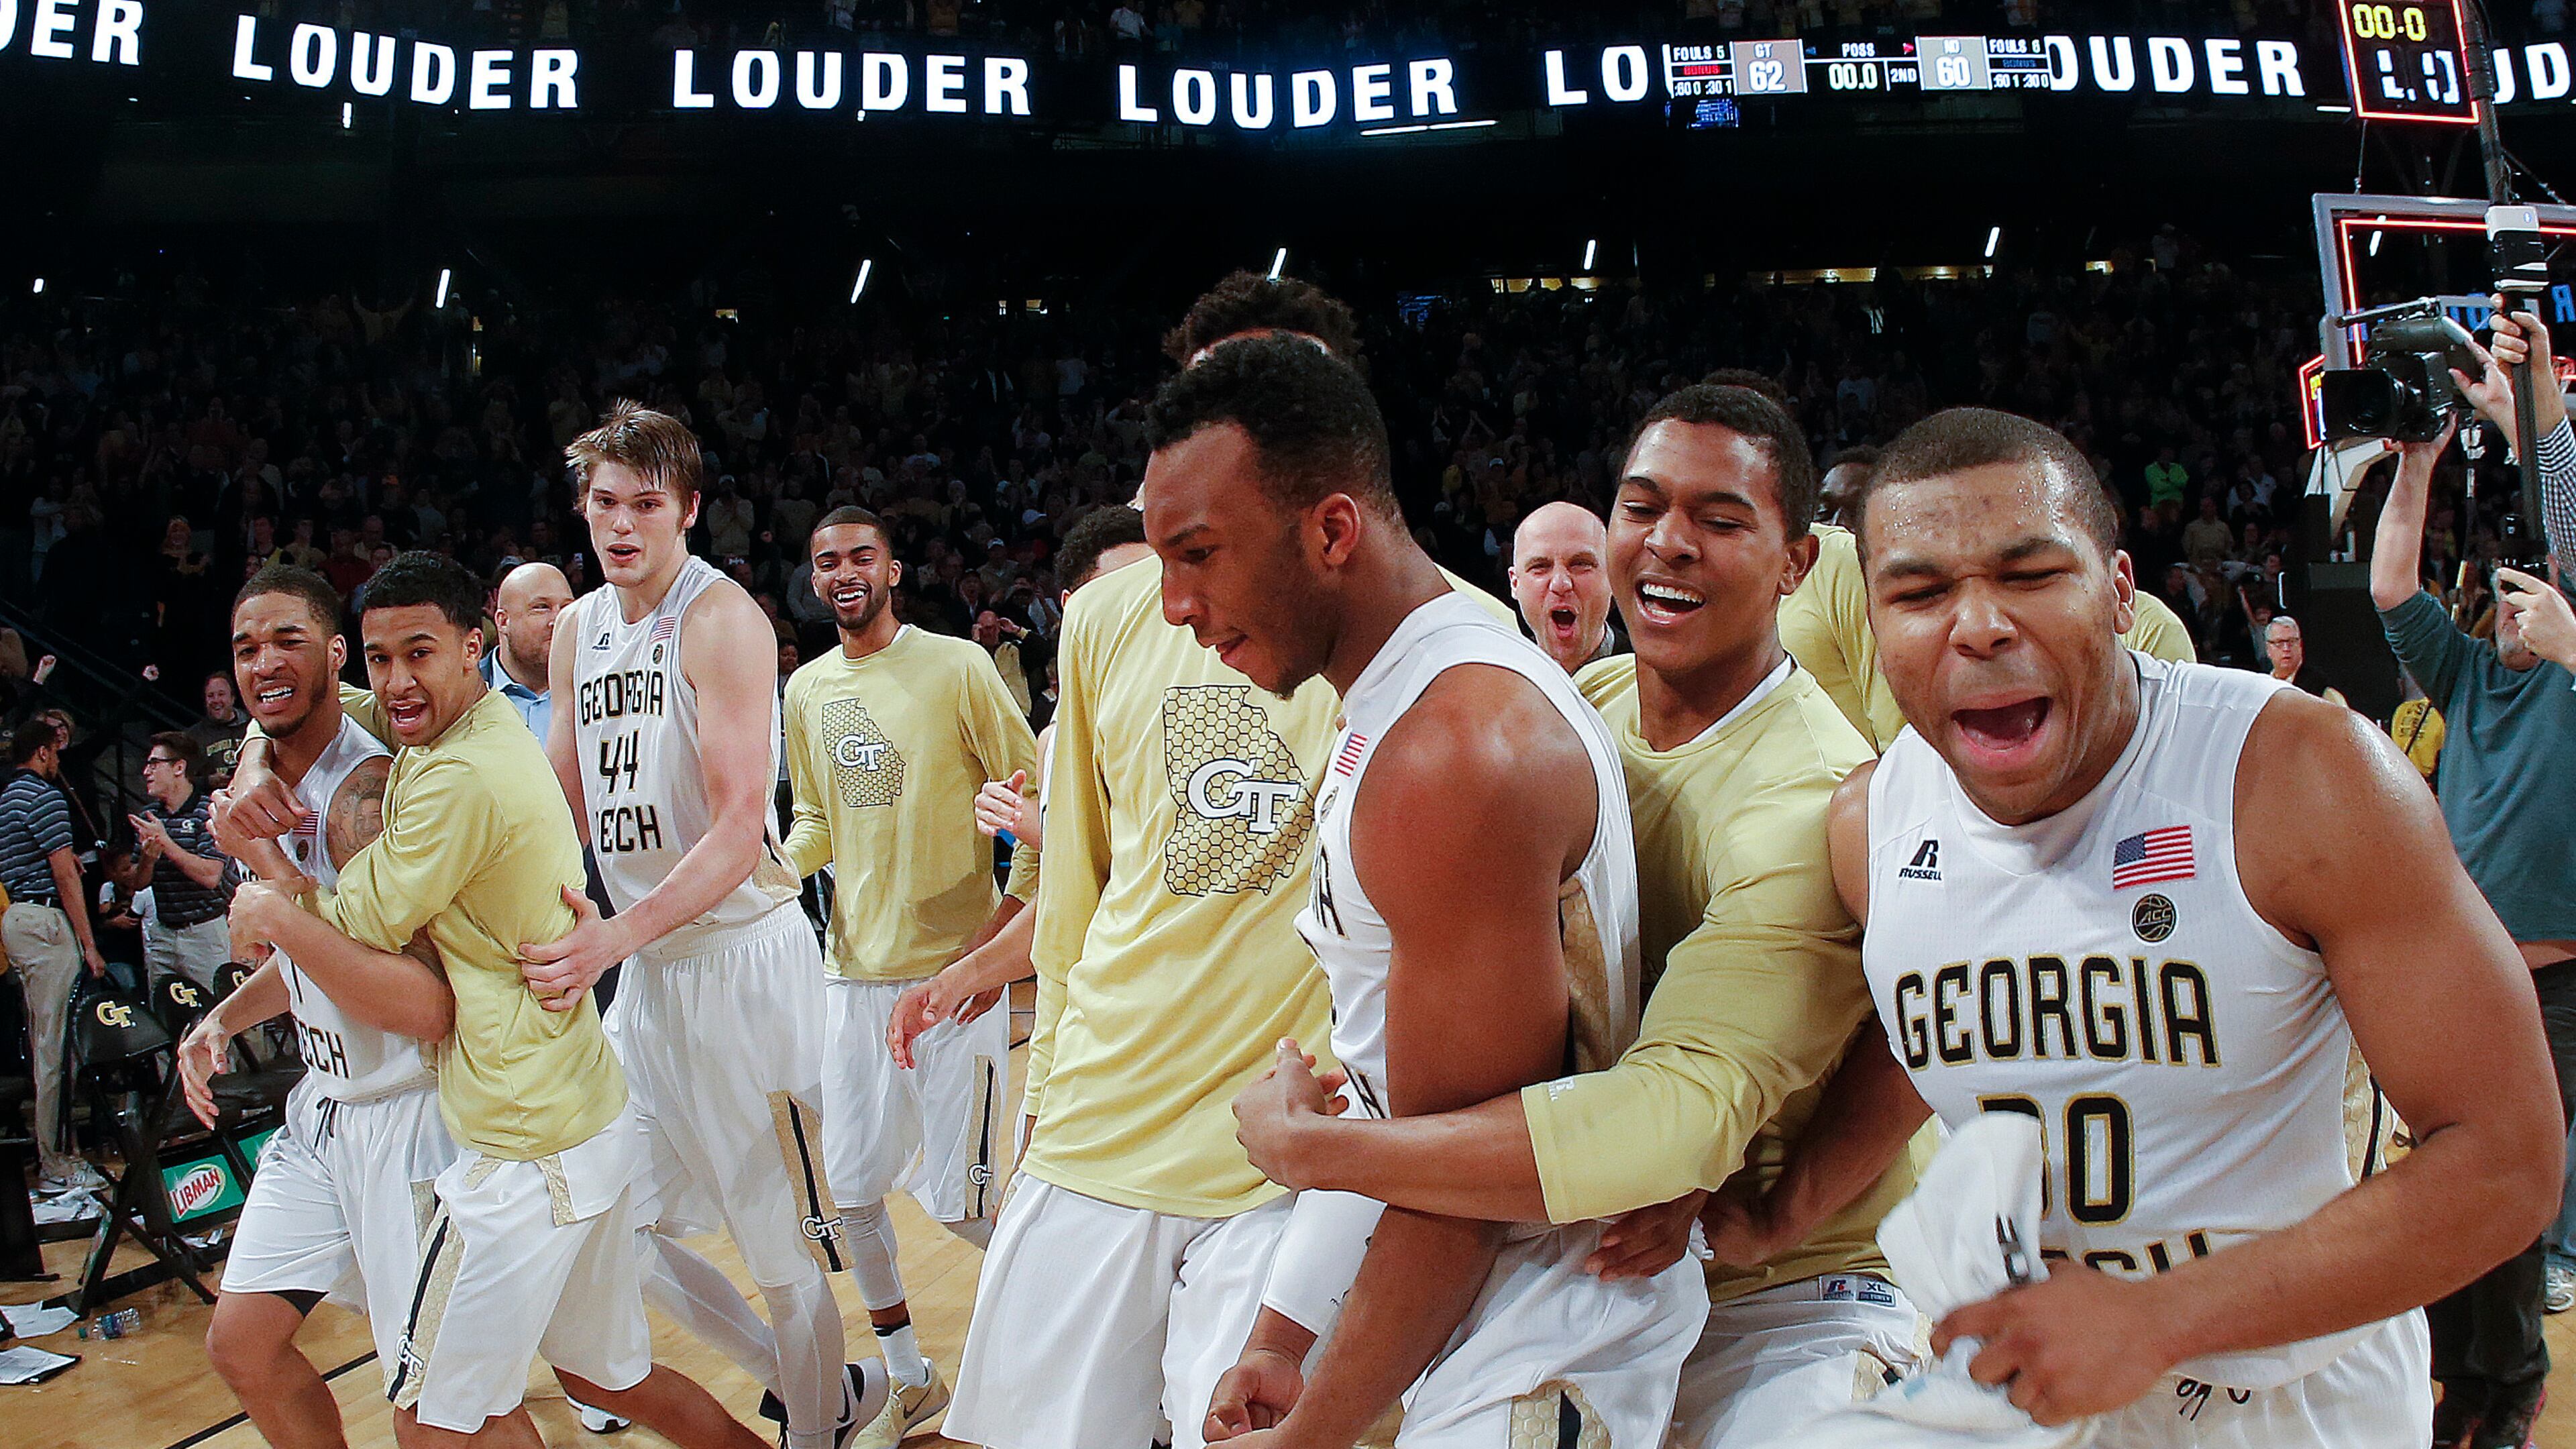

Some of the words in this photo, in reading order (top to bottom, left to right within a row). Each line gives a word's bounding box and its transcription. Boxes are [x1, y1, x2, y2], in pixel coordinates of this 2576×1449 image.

[1673, 46, 1712, 61] FOULS
[1716, 45, 1725, 60] 5
[1755, 44, 1774, 58] GT
[1841, 42, 1876, 58] POSS
[1989, 38, 2027, 54] FOULS
[233, 15, 578, 109] LOUDER
[1749, 60, 1787, 92] 62
[1828, 62, 1878, 90] 00.0
[1890, 67, 1917, 83] 2ND
[1935, 56, 1973, 88] 60
[674, 50, 1031, 115] LOUDER
[1119, 58, 1458, 129] LOUDER
[580, 670, 665, 728] GEORGIA
[599, 727, 641, 796] 44
[835, 732, 887, 771] GT
[1186, 758, 1302, 835] GT
[1898, 867, 1943, 881] RUSSELL
[231, 970, 251, 988] G
[169, 981, 199, 1008] GT
[96, 1000, 132, 1028] GT
[1893, 951, 2224, 1075] GEORGIA
[172, 1166, 221, 1218] LIBMAN
[800, 1215, 844, 1241] GT
[1866, 1281, 1886, 1293] XL
